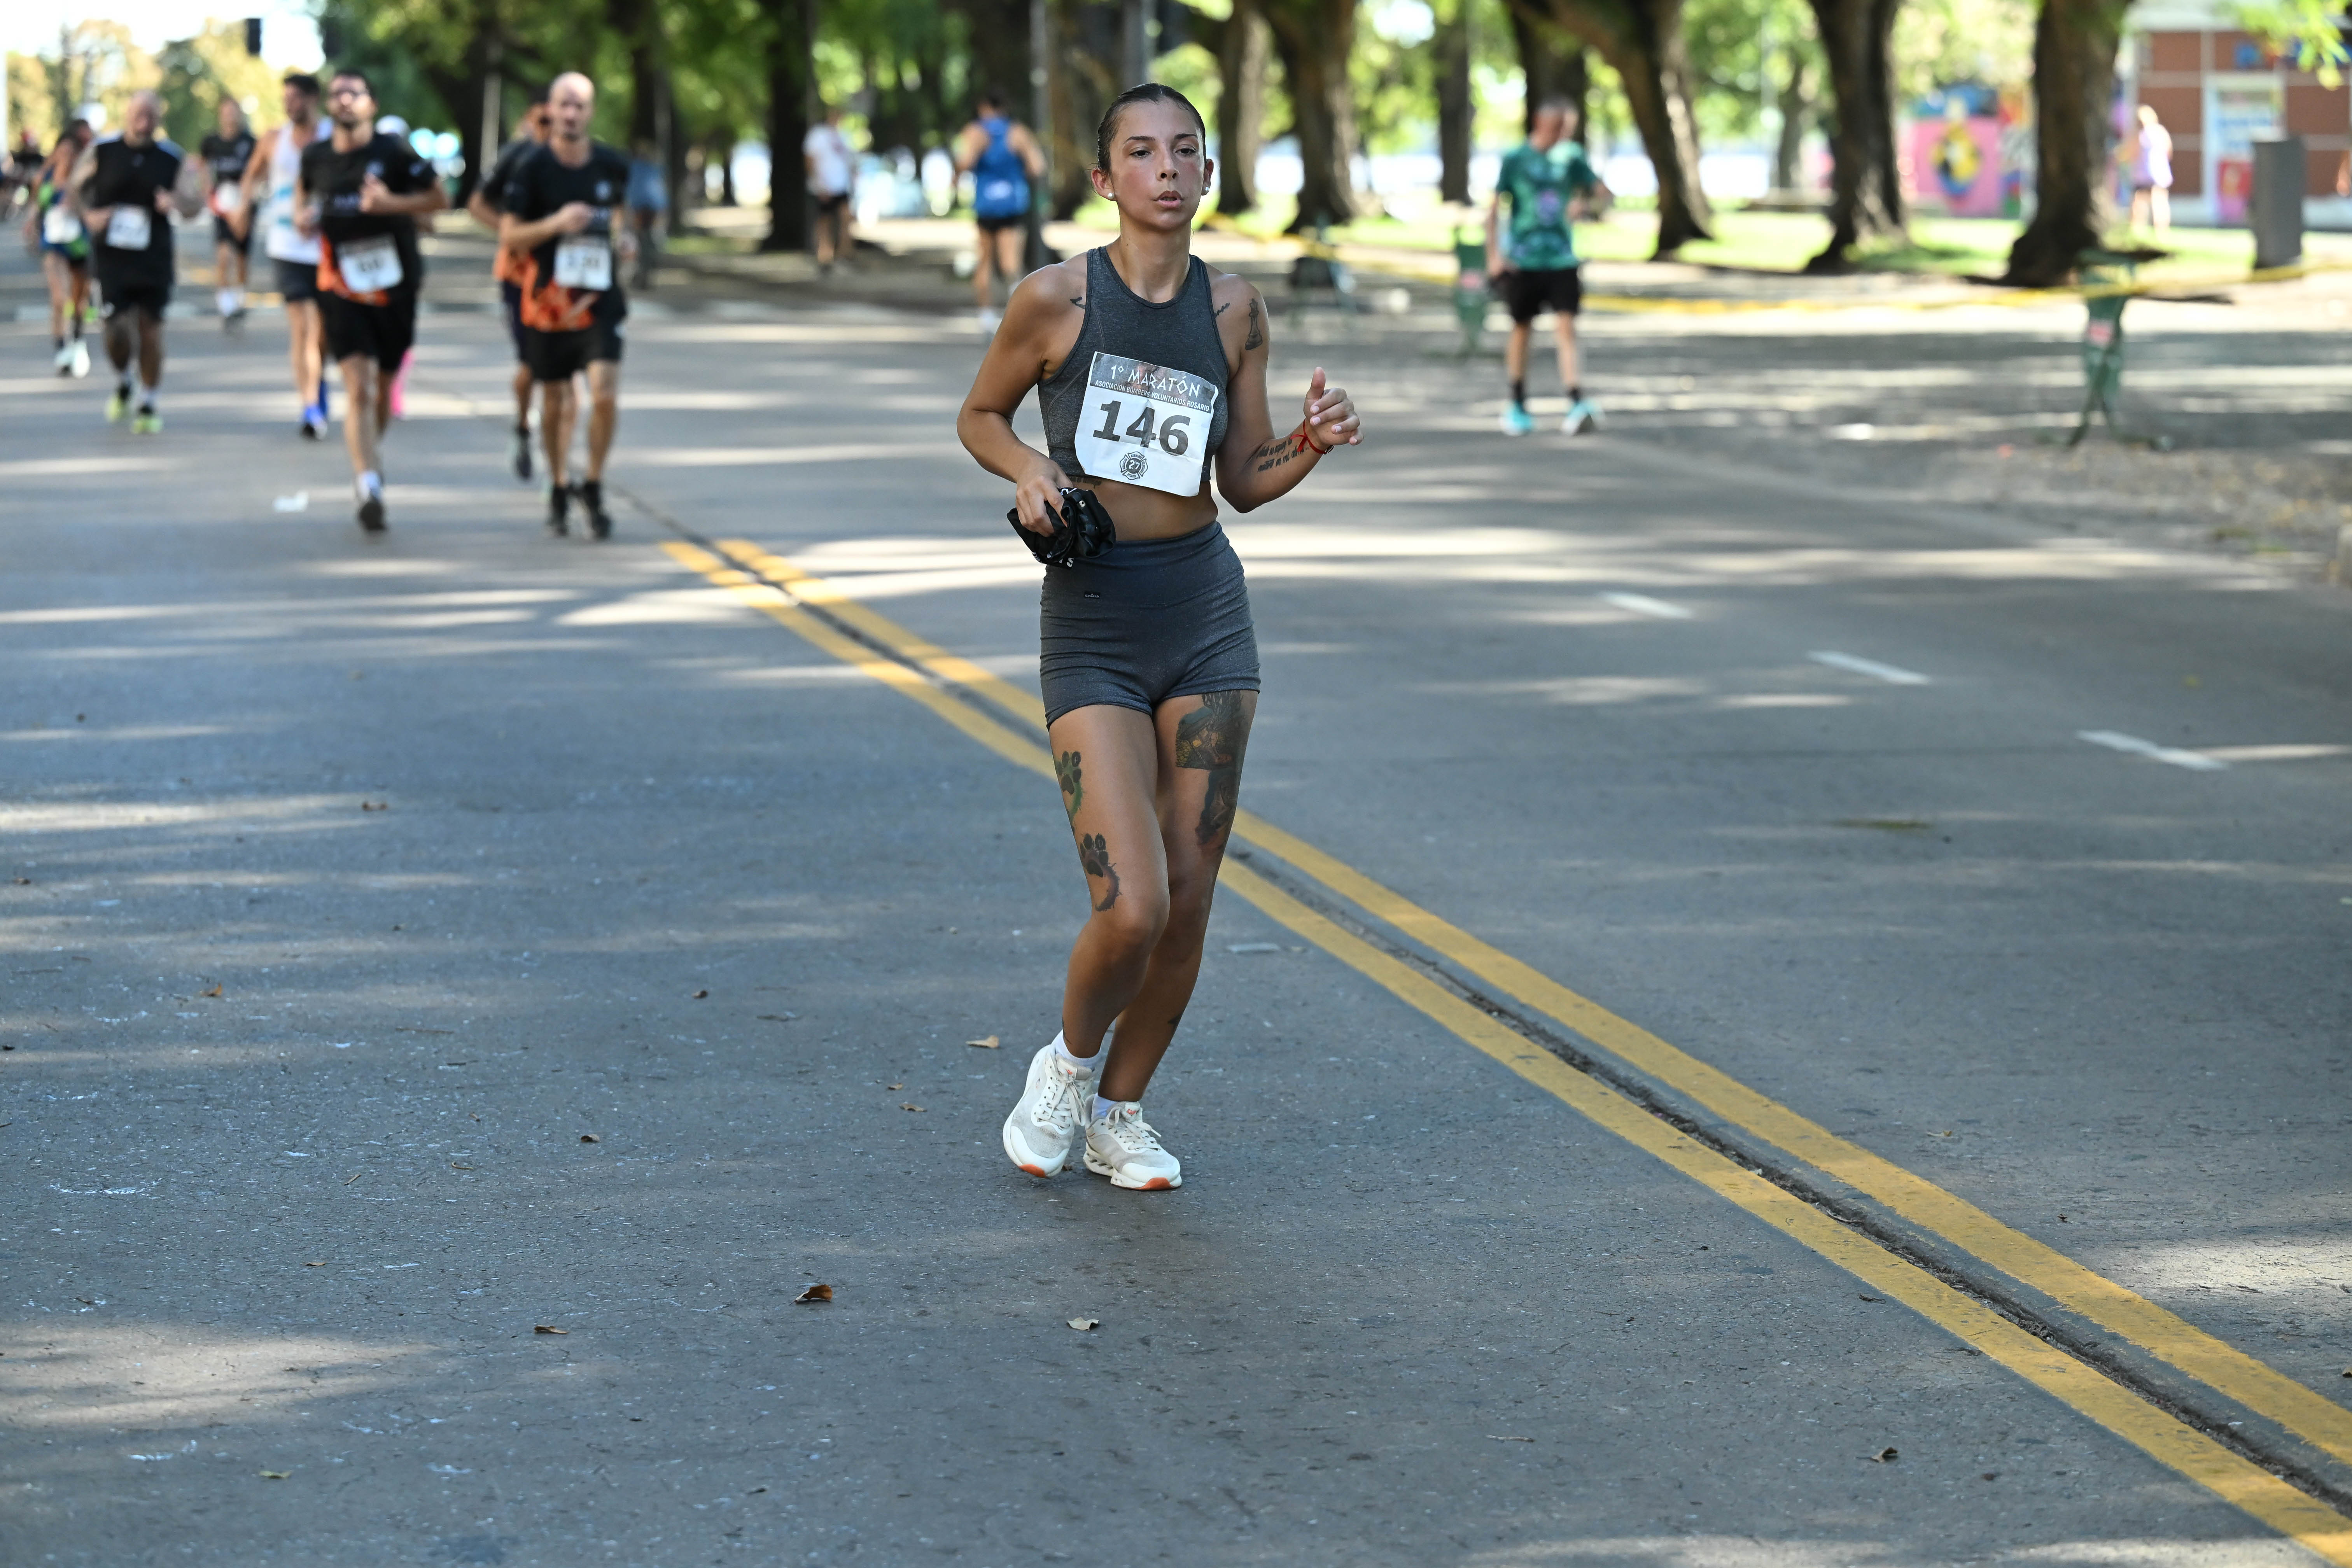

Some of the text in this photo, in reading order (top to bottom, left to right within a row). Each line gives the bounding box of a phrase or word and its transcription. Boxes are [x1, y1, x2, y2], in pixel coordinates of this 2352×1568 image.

[1095, 380, 1126, 392] ASOCIACION
[1151, 392, 1186, 405] VOLUNTARIOS
[1186, 400, 1209, 412] ROSARIO
[1128, 369, 1200, 397] MARATÓN
[1093, 400, 1191, 456] 146
[1129, 459, 1140, 470] 27
